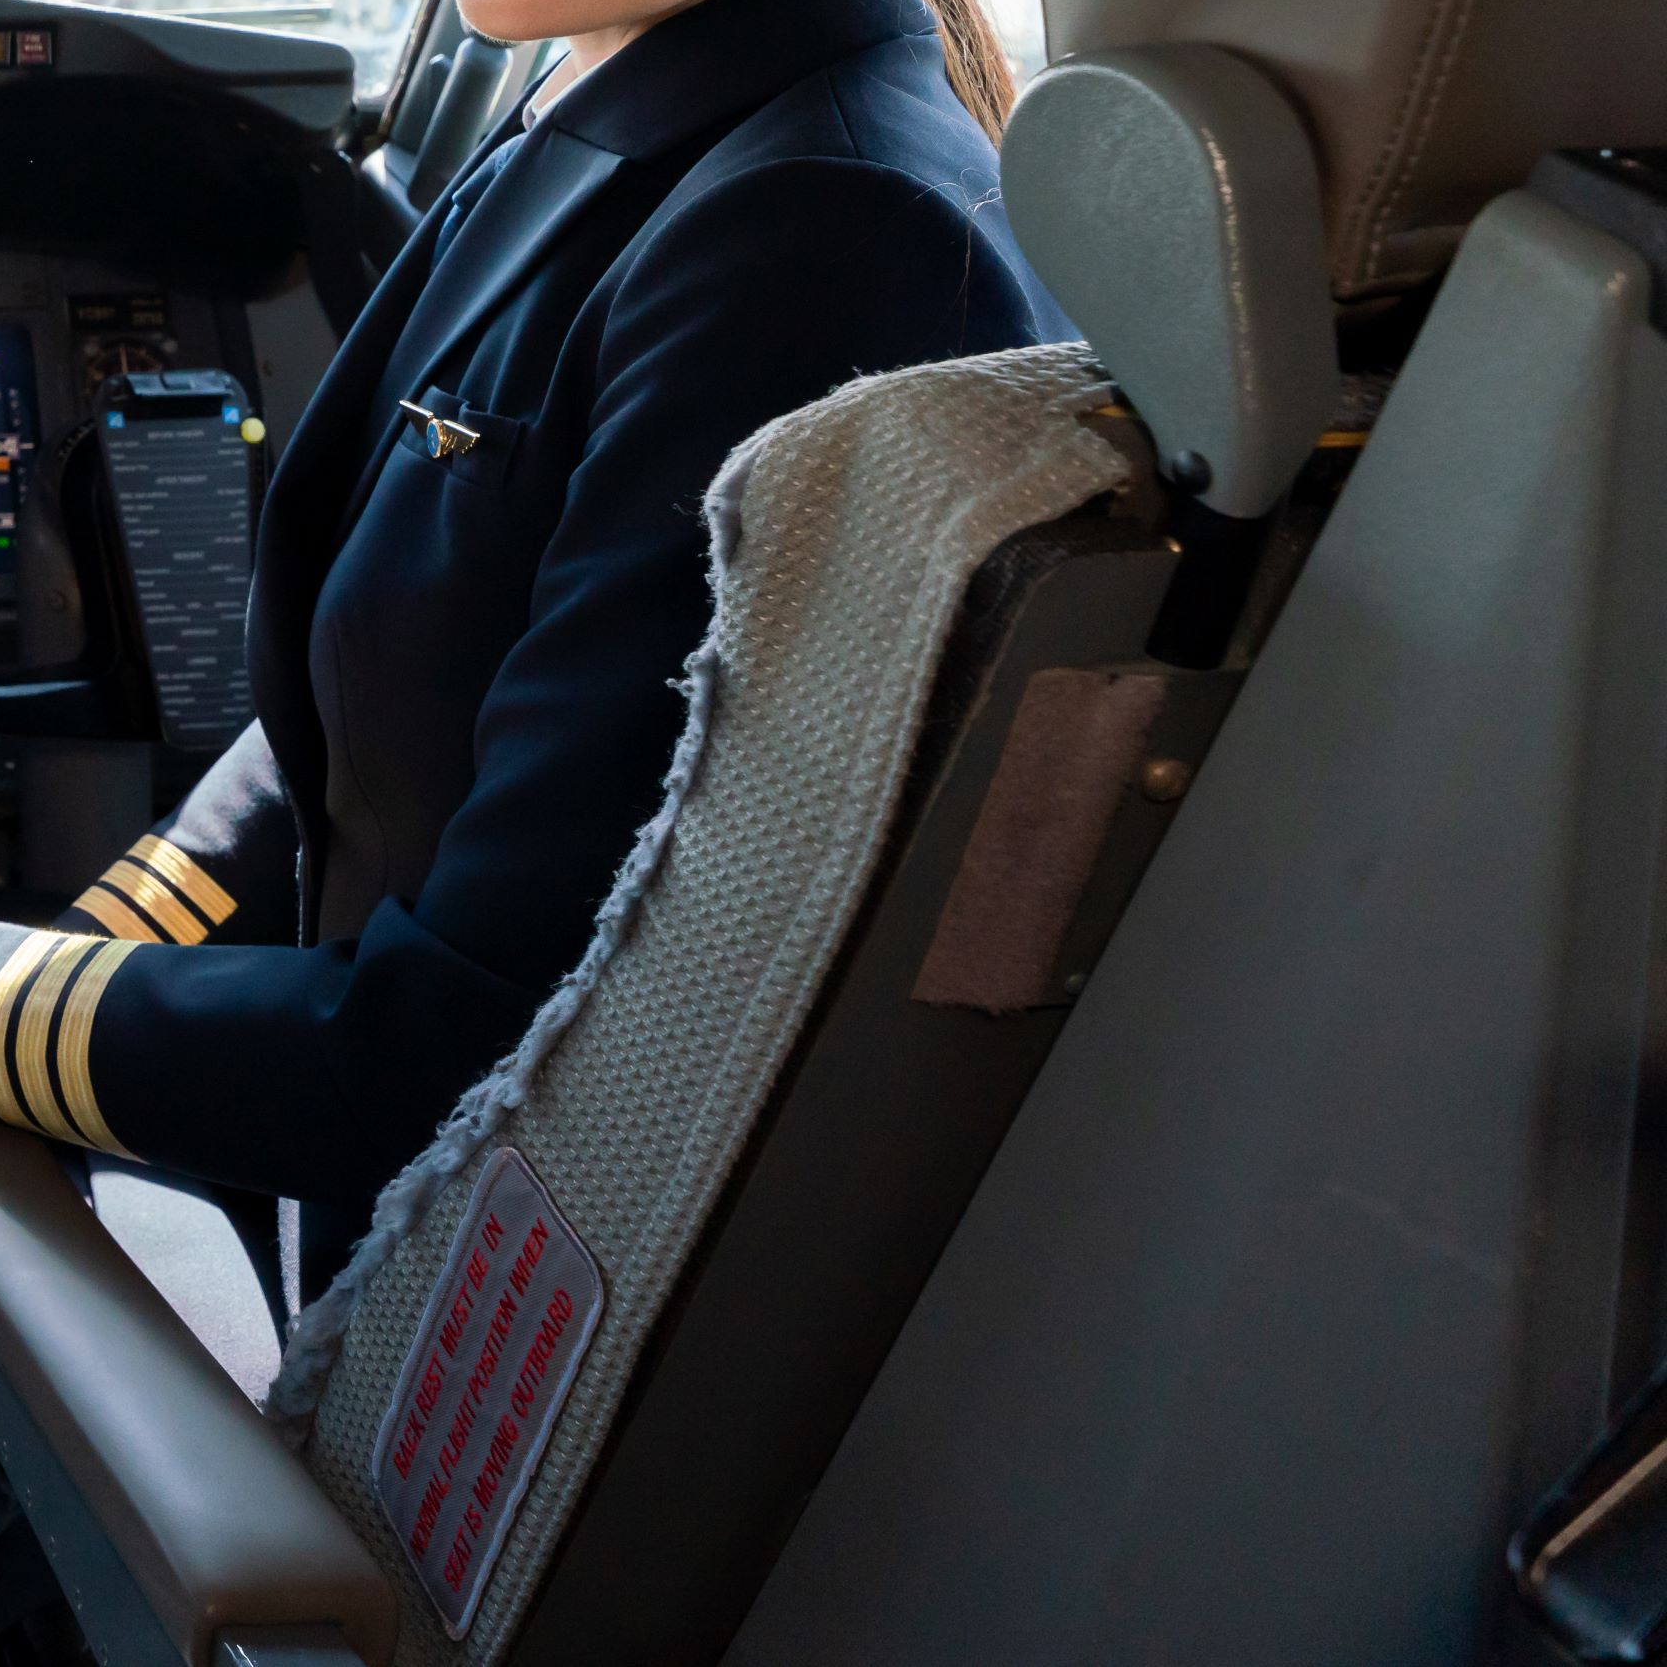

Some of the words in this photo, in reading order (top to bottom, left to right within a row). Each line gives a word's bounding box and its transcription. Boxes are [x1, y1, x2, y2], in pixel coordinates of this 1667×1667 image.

[393, 1407, 427, 1481] BACK
[418, 1346, 448, 1420] REST
[439, 1280, 475, 1359] MUST
[466, 1242, 491, 1292] BE
[482, 1211, 506, 1247] IN
[410, 1471, 452, 1564] NORMAL
[439, 1389, 477, 1480] FLIGHT
[467, 1289, 519, 1406] POSITION
[508, 1216, 550, 1298] WHEN
[443, 1535, 473, 1593] SEAT
[462, 1503, 483, 1540] IS
[473, 1413, 520, 1512] MOVING
[510, 1287, 573, 1419] OUTBOARD
